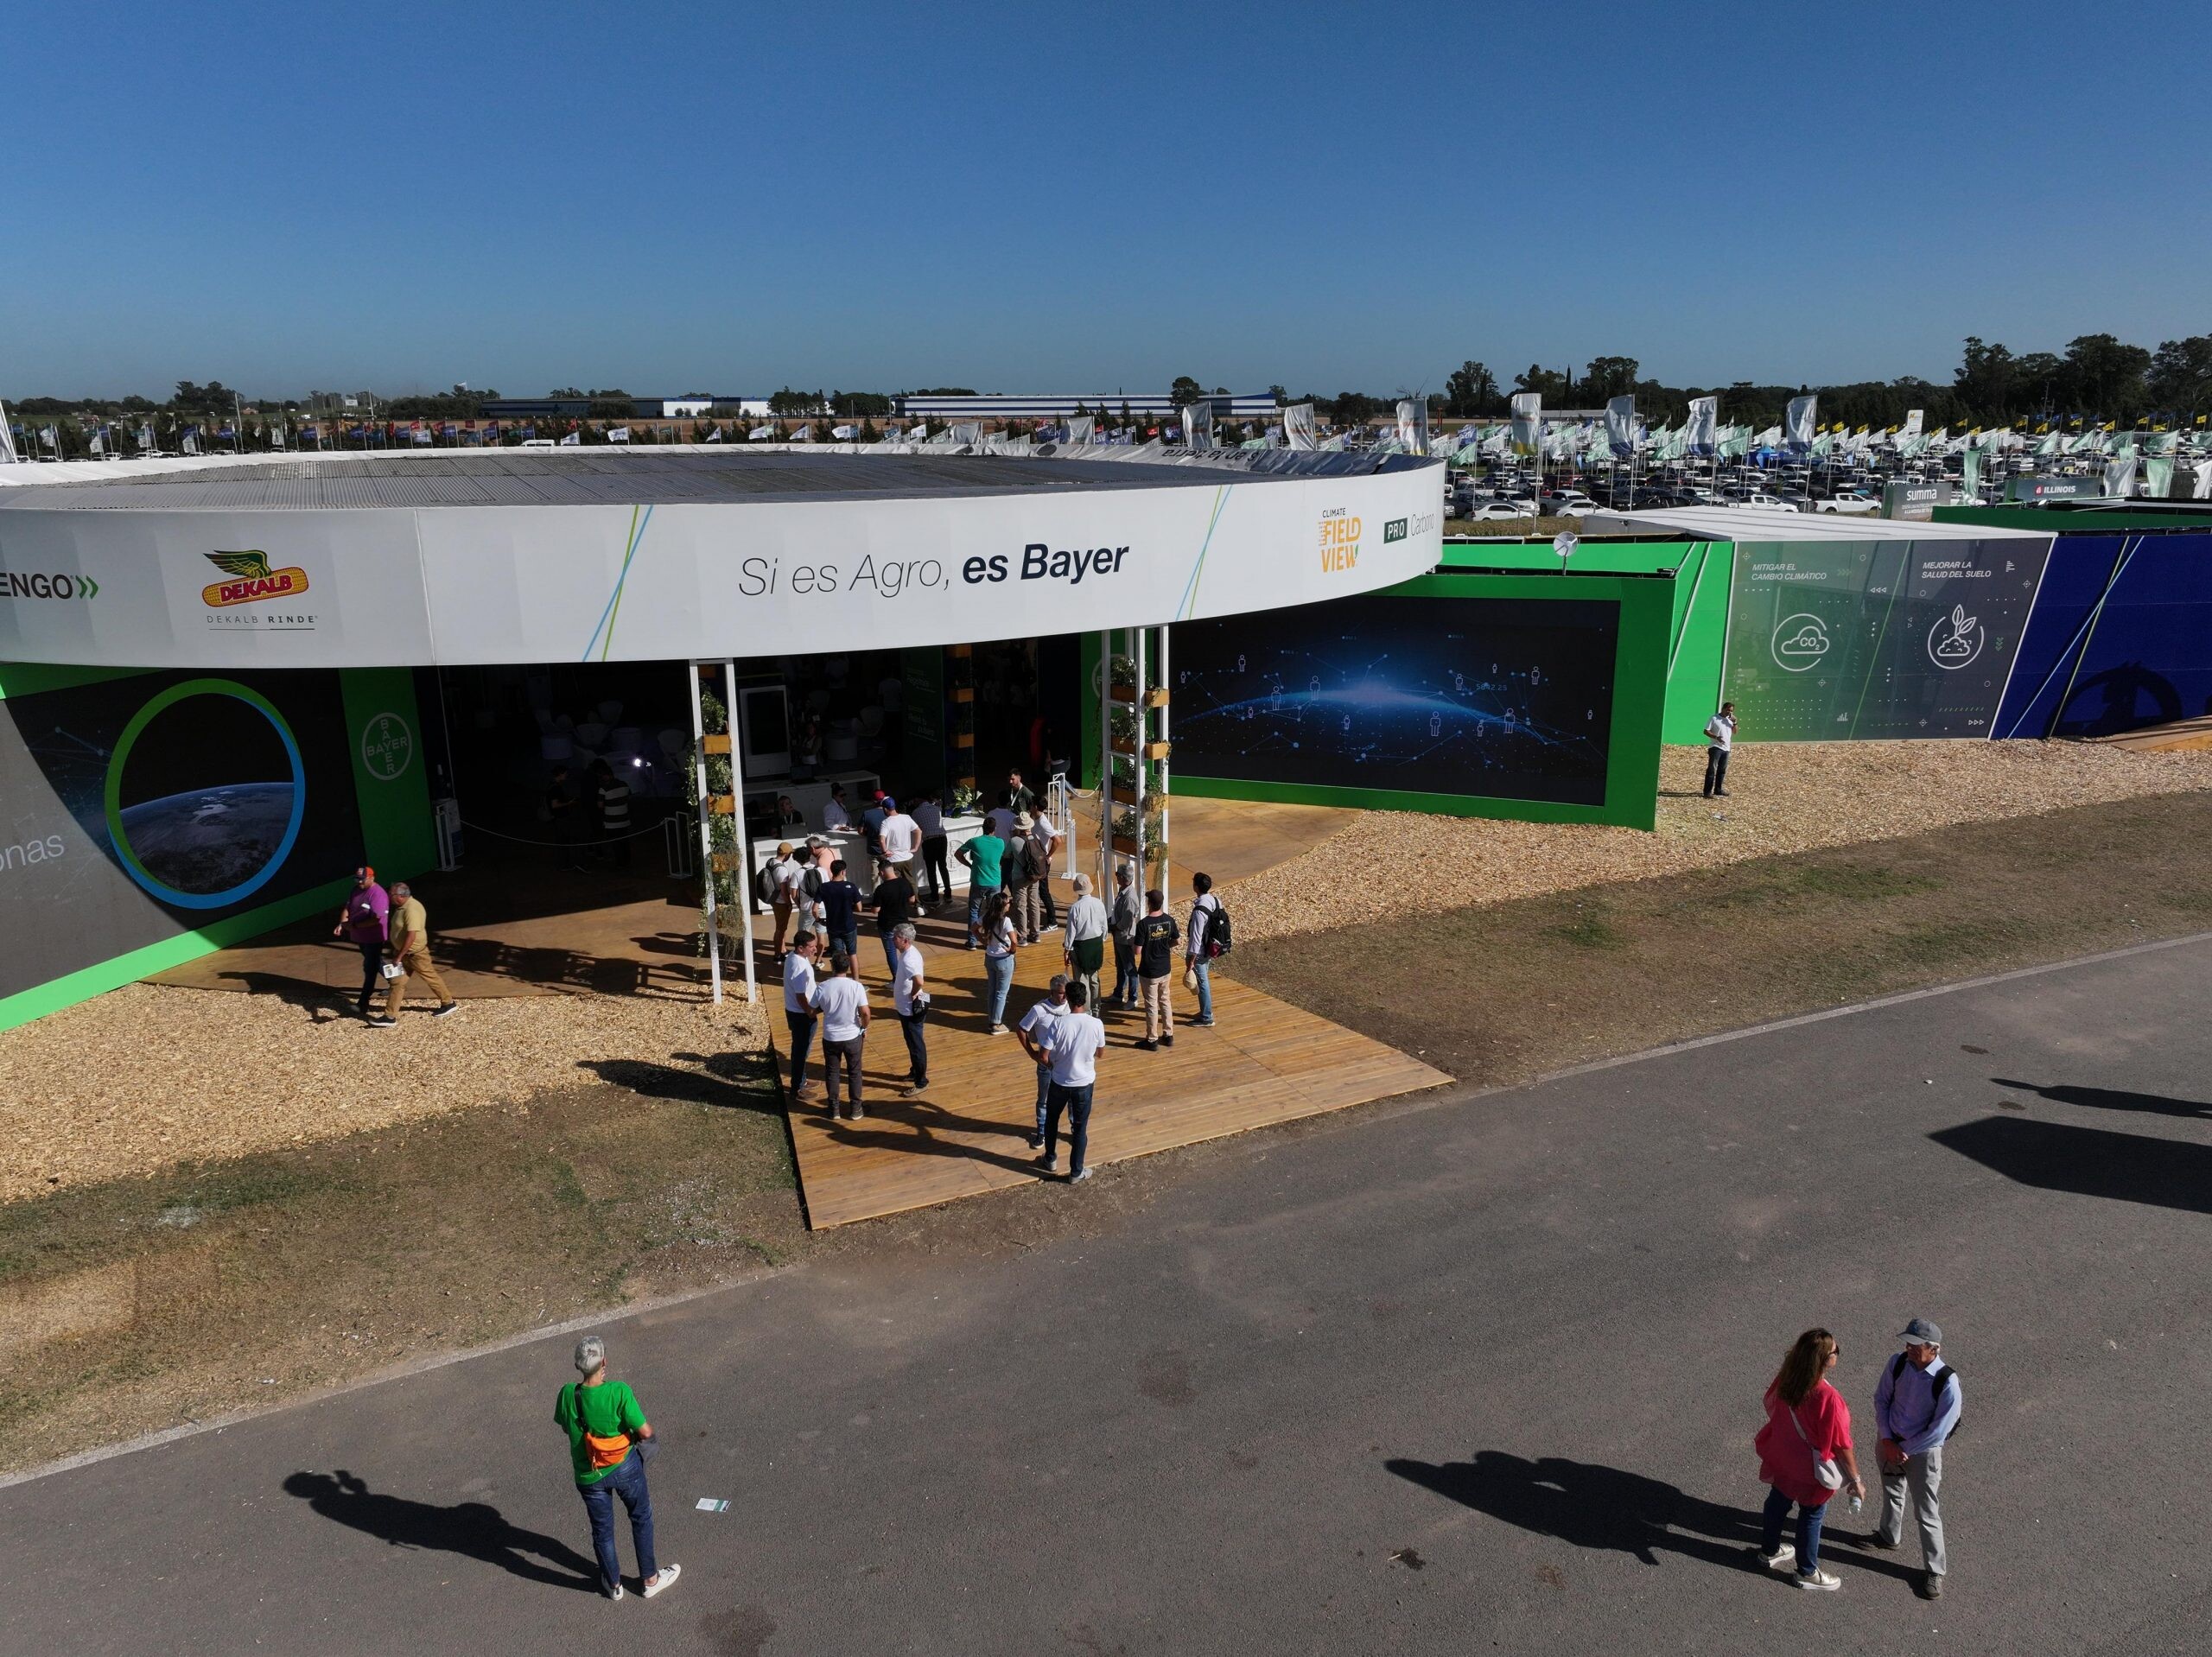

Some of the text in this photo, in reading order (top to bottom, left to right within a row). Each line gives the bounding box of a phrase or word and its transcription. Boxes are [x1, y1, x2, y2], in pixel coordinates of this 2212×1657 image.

[1906, 489, 1937, 501] summa
[1322, 507, 1346, 518] CLIMATE
[1325, 517, 1362, 545] FIELD
[1388, 521, 1405, 540] PRO
[1321, 544, 1358, 573] VIEW
[739, 543, 1129, 598] Si es Agro, es Bayer
[1784, 571, 1827, 581] CLIMÁTICO
[219, 575, 293, 602] DEKALB
[207, 615, 258, 624] DEKALB
[365, 736, 409, 757] BAYER
[380, 719, 396, 775] BAYER
